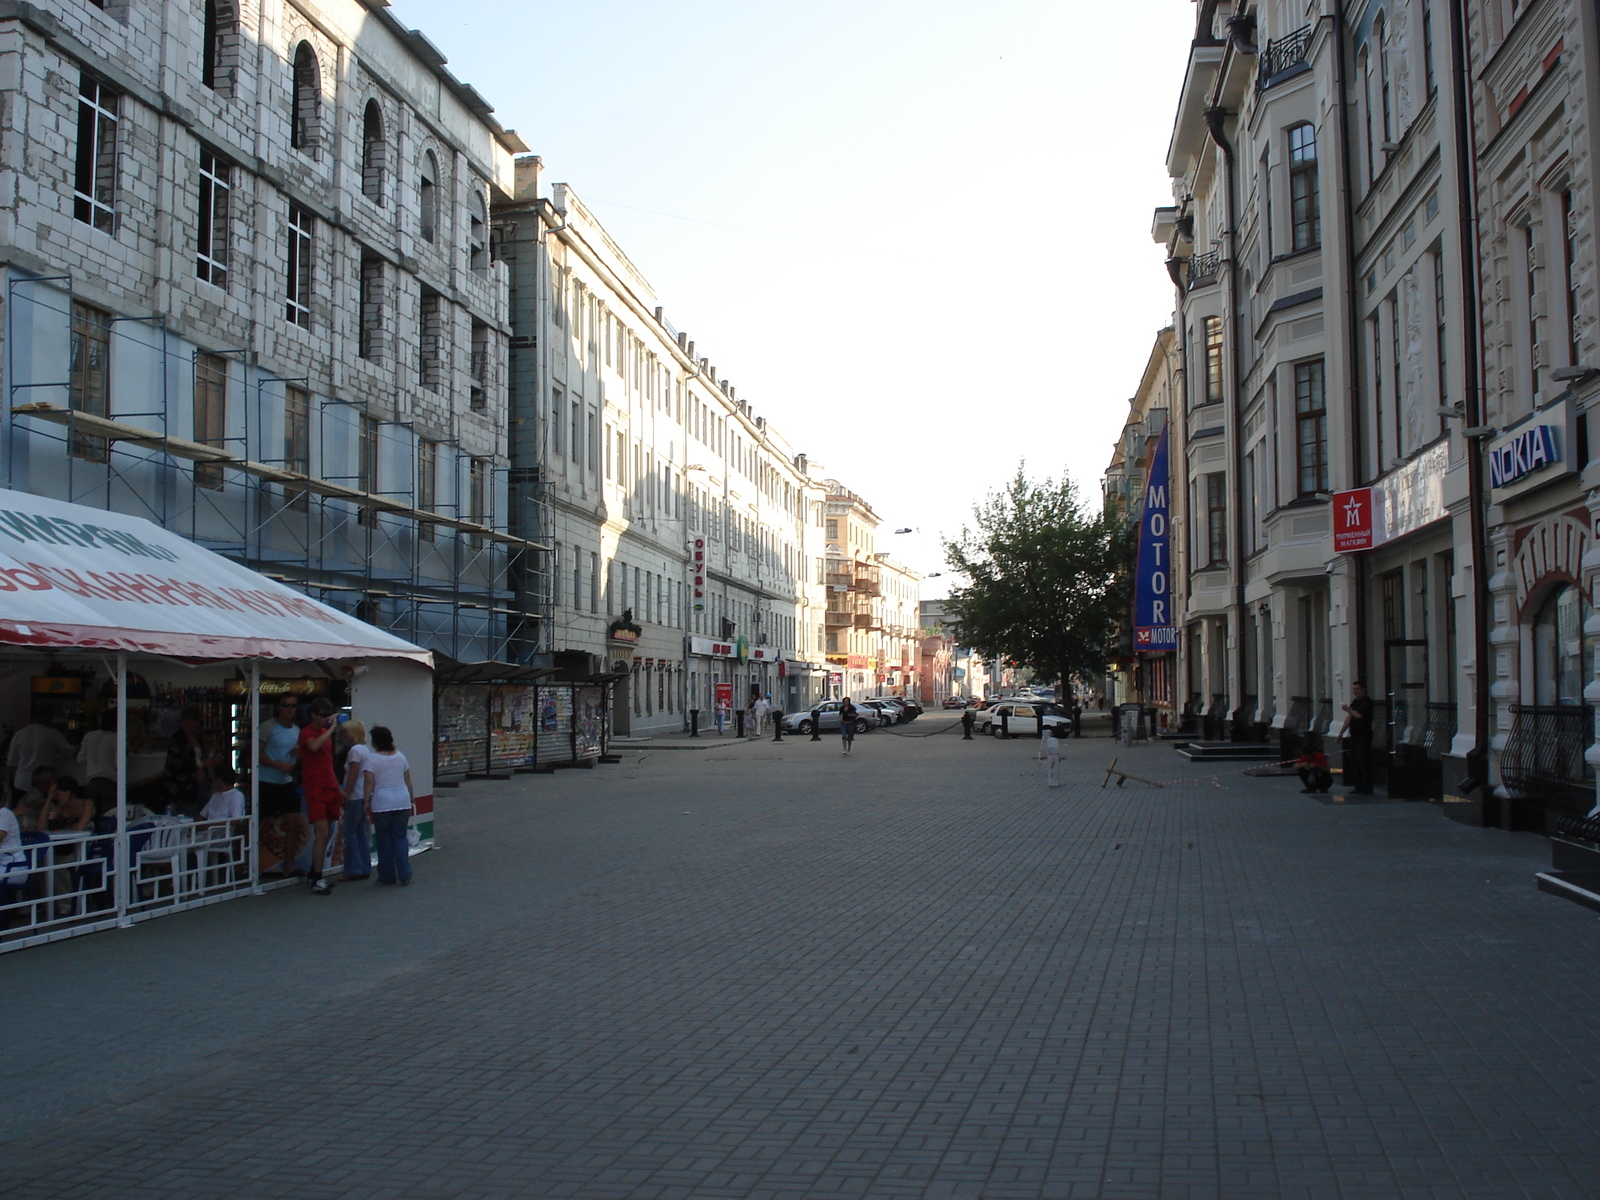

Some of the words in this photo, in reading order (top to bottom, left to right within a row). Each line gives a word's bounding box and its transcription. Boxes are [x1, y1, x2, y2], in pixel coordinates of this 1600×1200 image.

[1488, 425, 1554, 489] NOKIA
[694, 539, 704, 599] ОБУВЬ
[1148, 484, 1166, 624] MOTOR
[1340, 537, 1367, 549] МАГАЗИН
[1150, 626, 1176, 645] MOTOR
